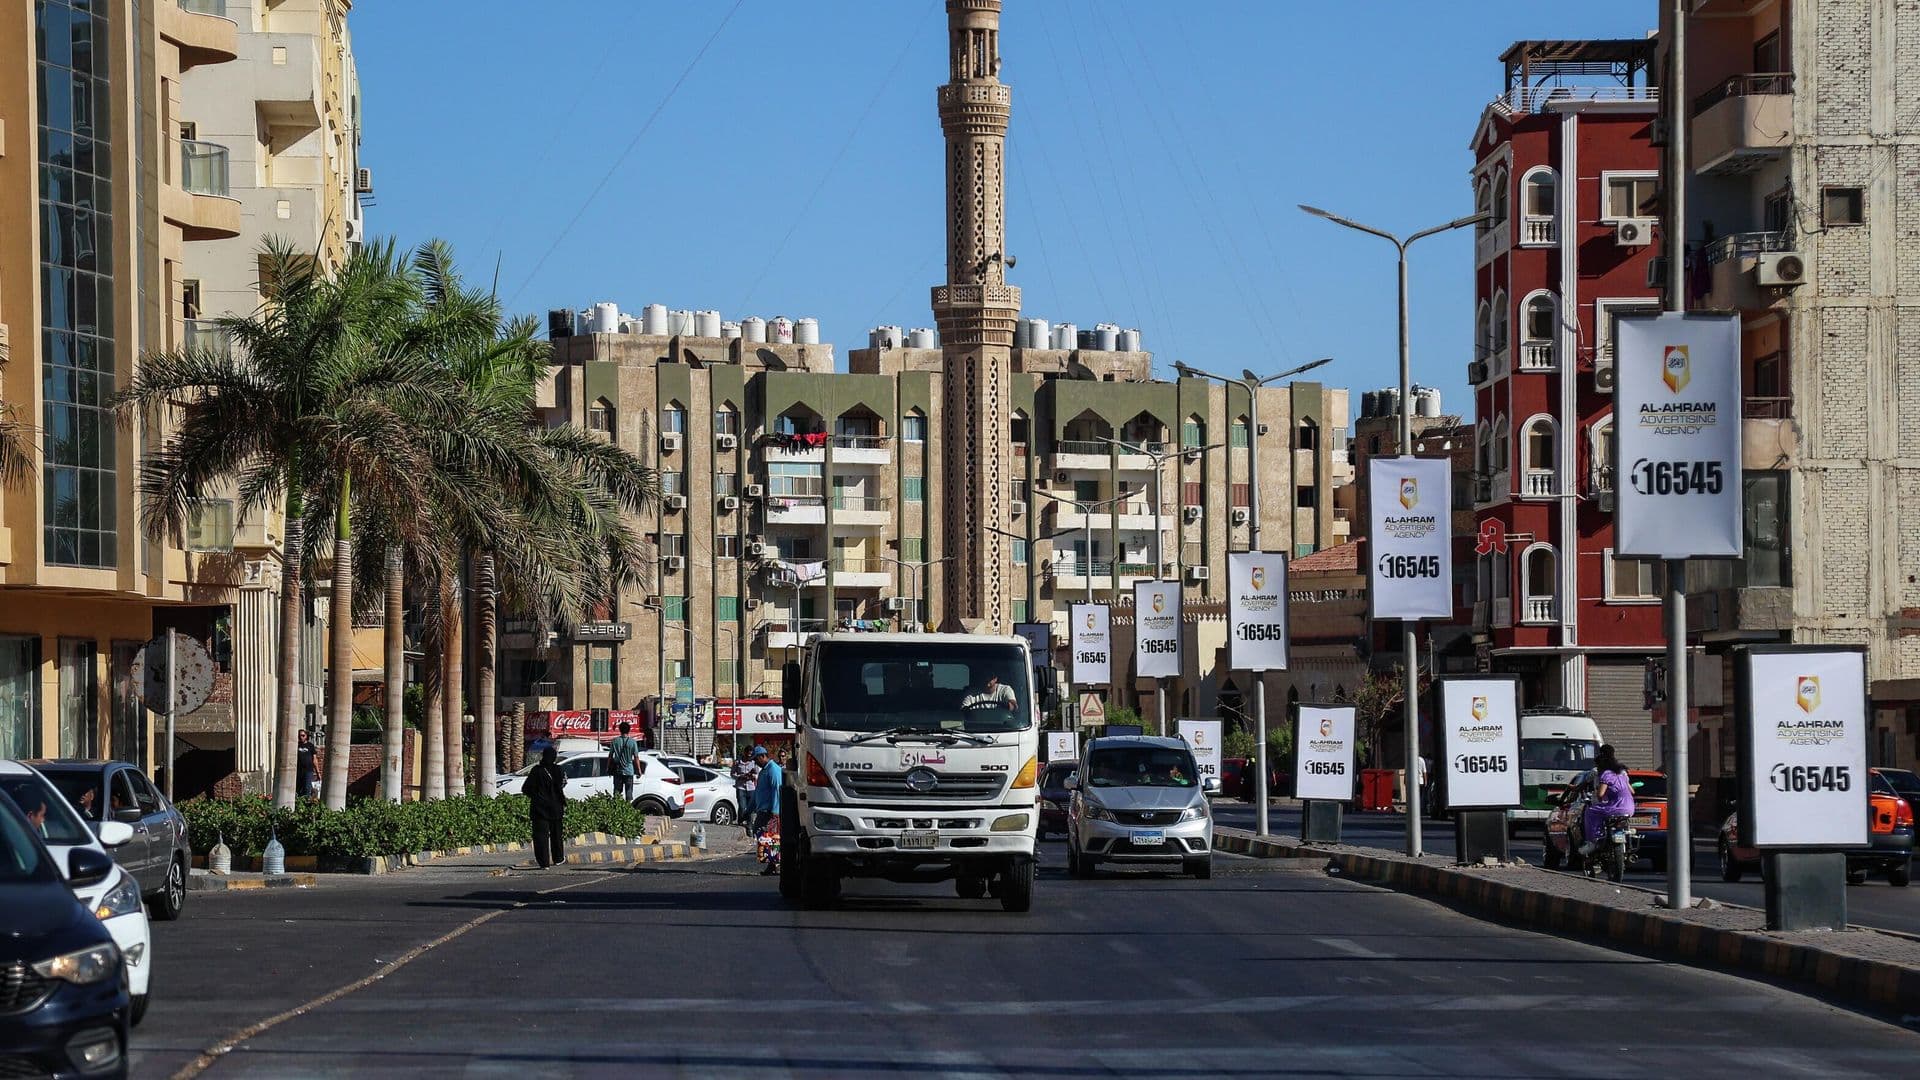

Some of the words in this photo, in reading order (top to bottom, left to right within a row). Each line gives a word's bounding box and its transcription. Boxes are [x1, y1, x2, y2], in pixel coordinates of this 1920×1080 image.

[1640, 402, 1716, 412] AL-AHRAM
[1640, 414, 1716, 424] ADVERTISING
[1654, 426, 1702, 435] AGENCY
[1642, 461, 1723, 495] 16545
[1386, 555, 1440, 578] 16545
[1242, 624, 1281, 641] 16545
[1145, 640, 1177, 653] 16545
[1081, 651, 1106, 663] 16545
[1777, 720, 1844, 728] AL-AHRAM
[1777, 729, 1844, 737] ADVERTISING
[832, 762, 873, 770] HINO
[1198, 764, 1215, 774] 545
[1310, 762, 1345, 775] 16545
[1462, 755, 1507, 773] 16545
[1780, 765, 1850, 792] 16545
